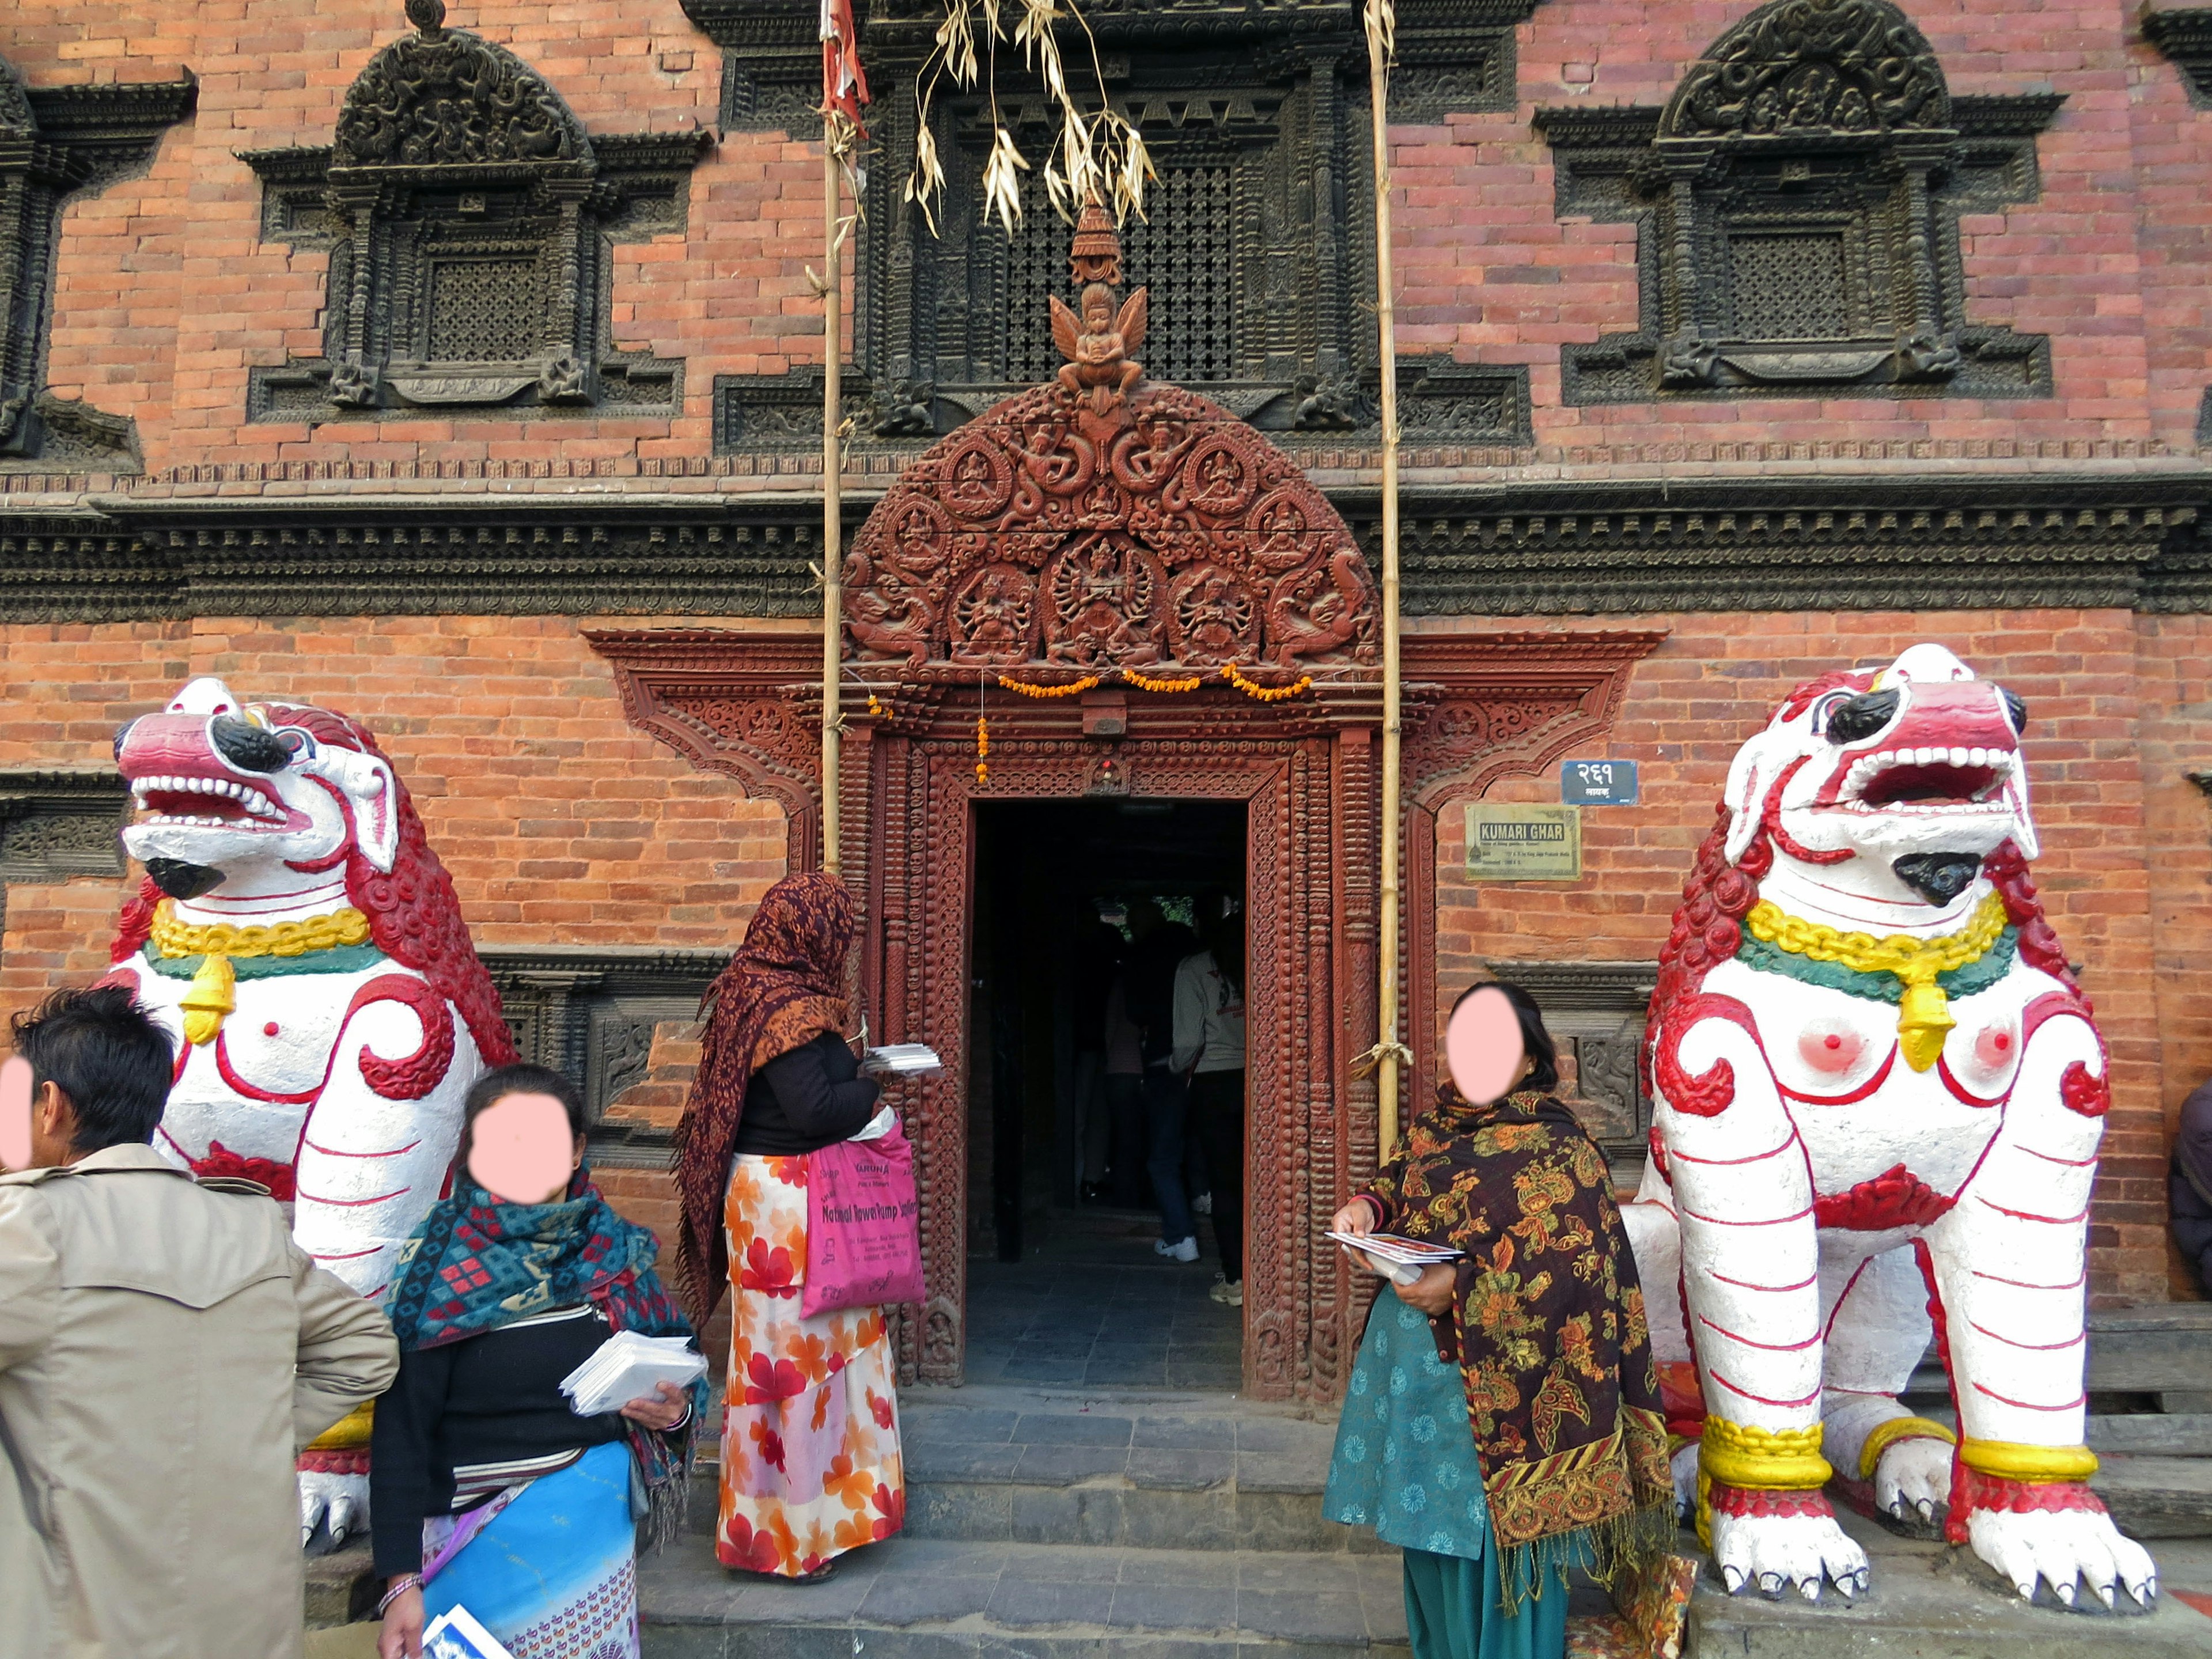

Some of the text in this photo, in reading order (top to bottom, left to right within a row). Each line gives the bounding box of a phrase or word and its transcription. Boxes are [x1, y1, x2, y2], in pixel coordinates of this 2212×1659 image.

[1577, 764, 1612, 785] २६१
[1482, 824, 1563, 840] KUMARI GHAR
